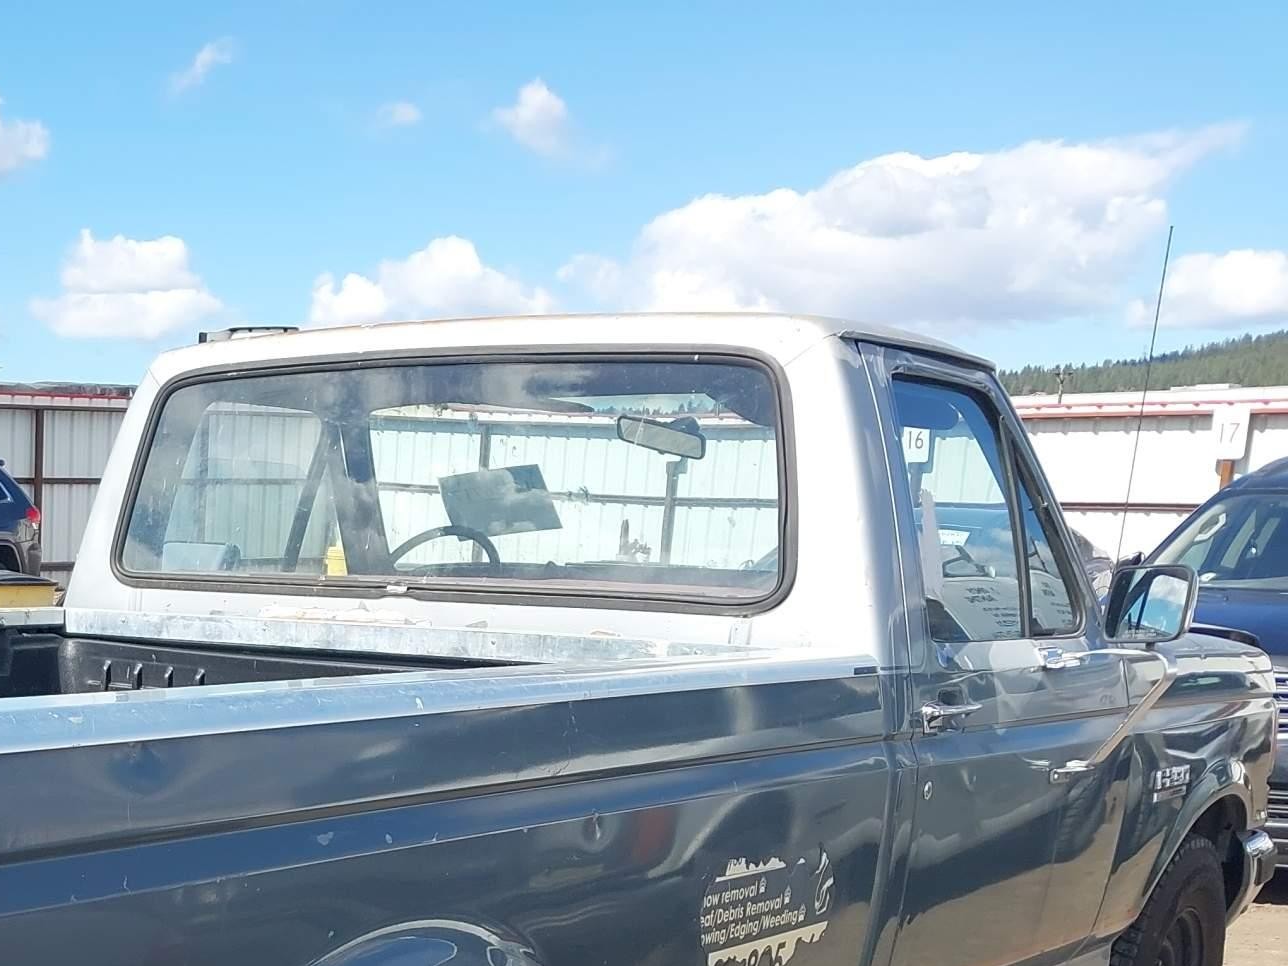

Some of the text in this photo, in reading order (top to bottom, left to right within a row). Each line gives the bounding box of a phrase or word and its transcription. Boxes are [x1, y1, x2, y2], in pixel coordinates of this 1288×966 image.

[908, 430, 924, 449] 16
[1219, 422, 1240, 444] 17
[721, 880, 759, 904] removal
[745, 894, 783, 915] Removal
